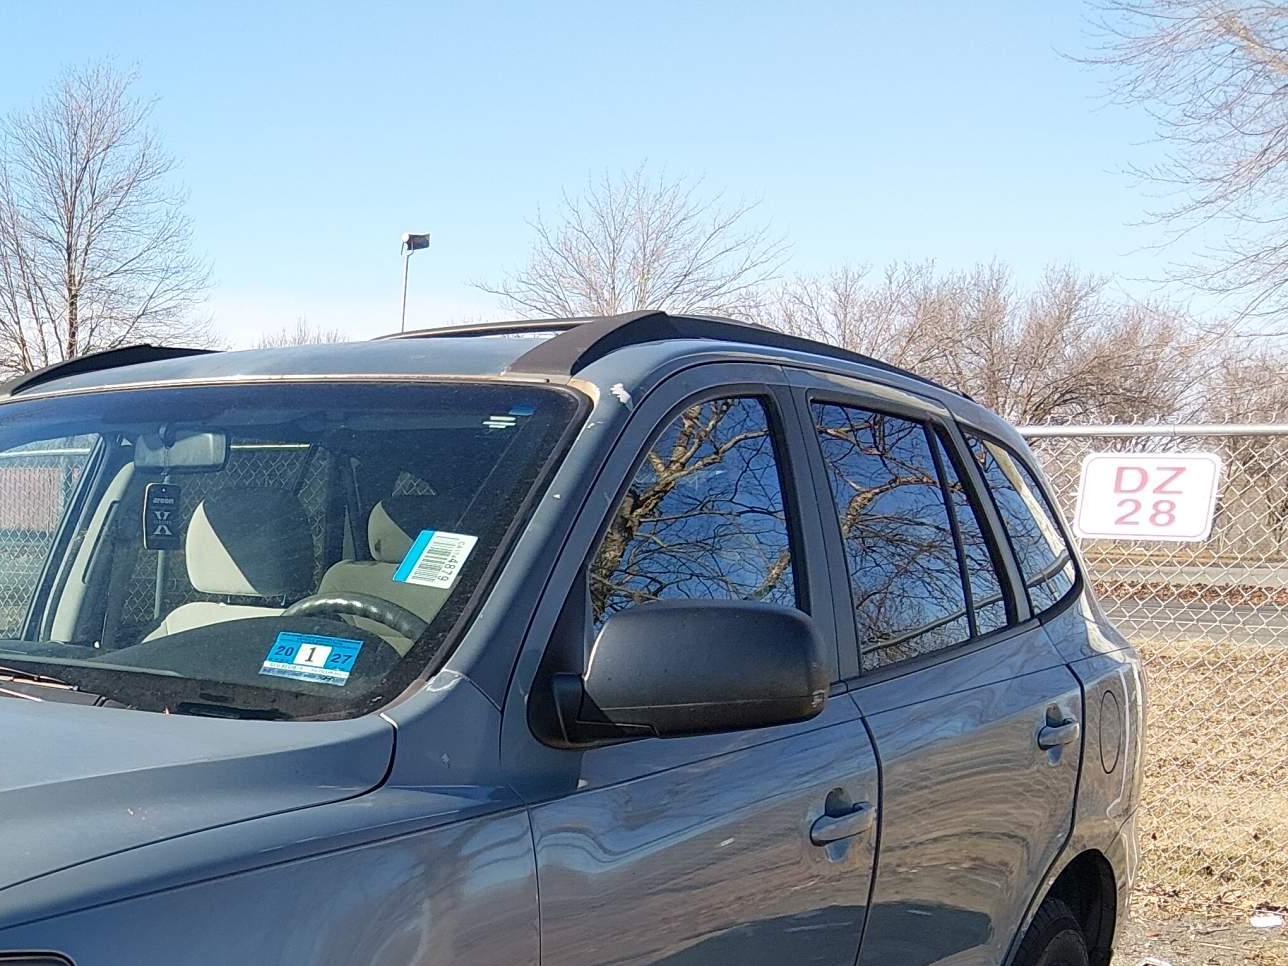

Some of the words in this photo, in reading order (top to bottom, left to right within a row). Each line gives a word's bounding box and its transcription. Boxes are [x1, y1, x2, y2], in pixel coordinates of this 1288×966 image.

[1113, 466, 1187, 494] DZ
[1114, 499, 1176, 527] 28
[274, 645, 295, 657] 20
[305, 647, 318, 662] 1
[330, 653, 353, 664] 27
